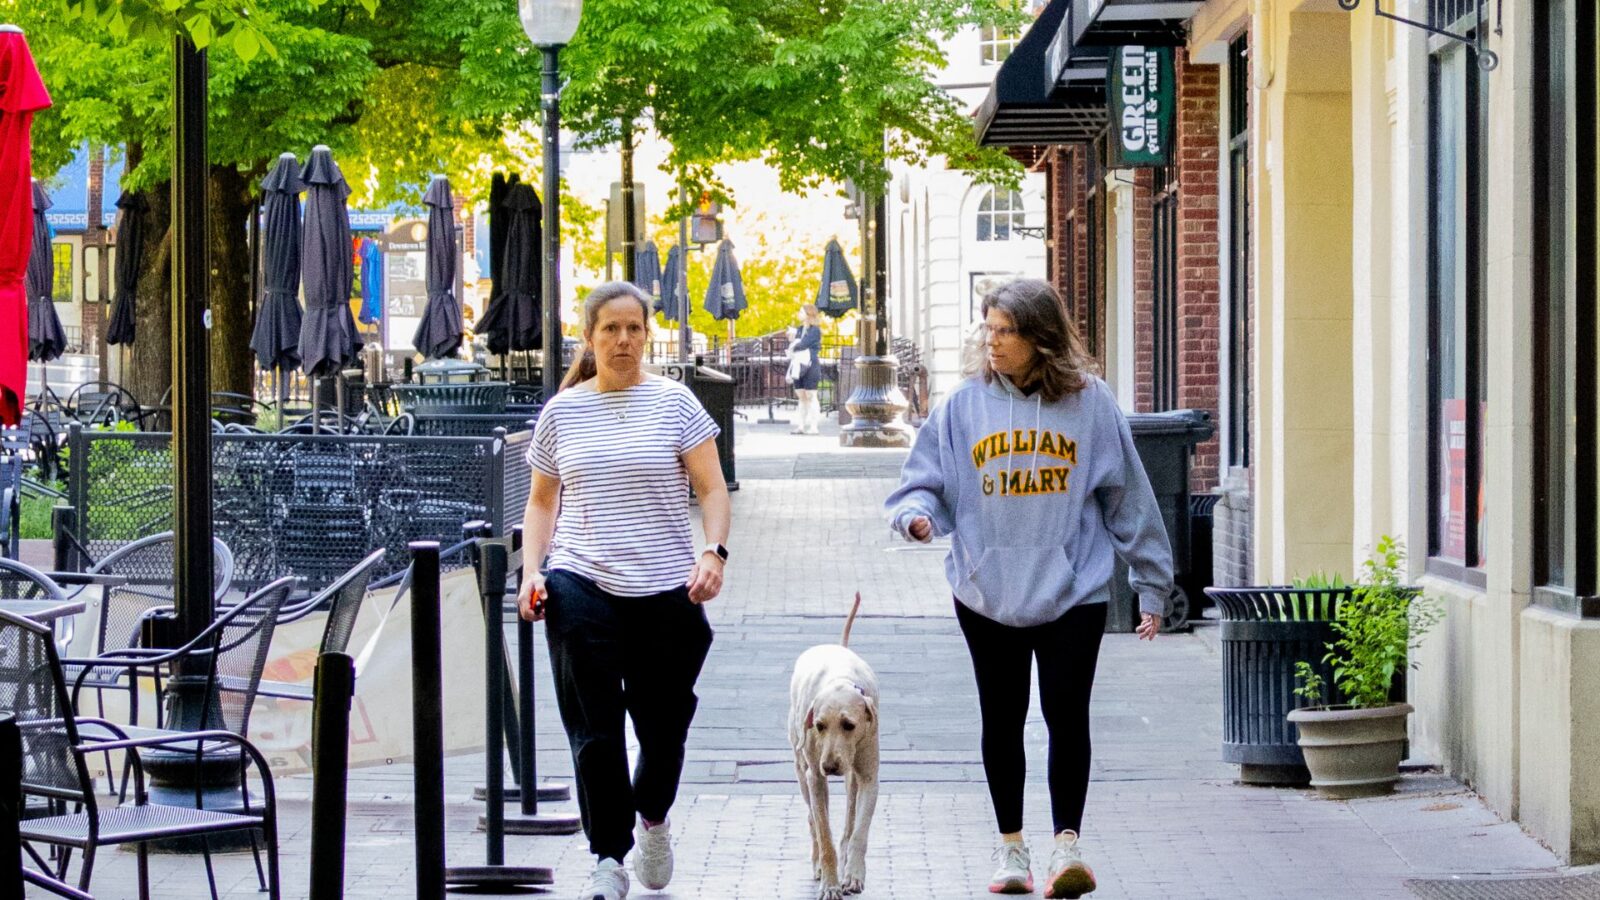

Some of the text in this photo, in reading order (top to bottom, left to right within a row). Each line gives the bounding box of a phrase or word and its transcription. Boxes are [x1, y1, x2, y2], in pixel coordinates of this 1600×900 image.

[1145, 51, 1160, 155] grill & sushi
[971, 429, 1077, 469] WILLIAM
[982, 467, 1070, 496] & MARY
